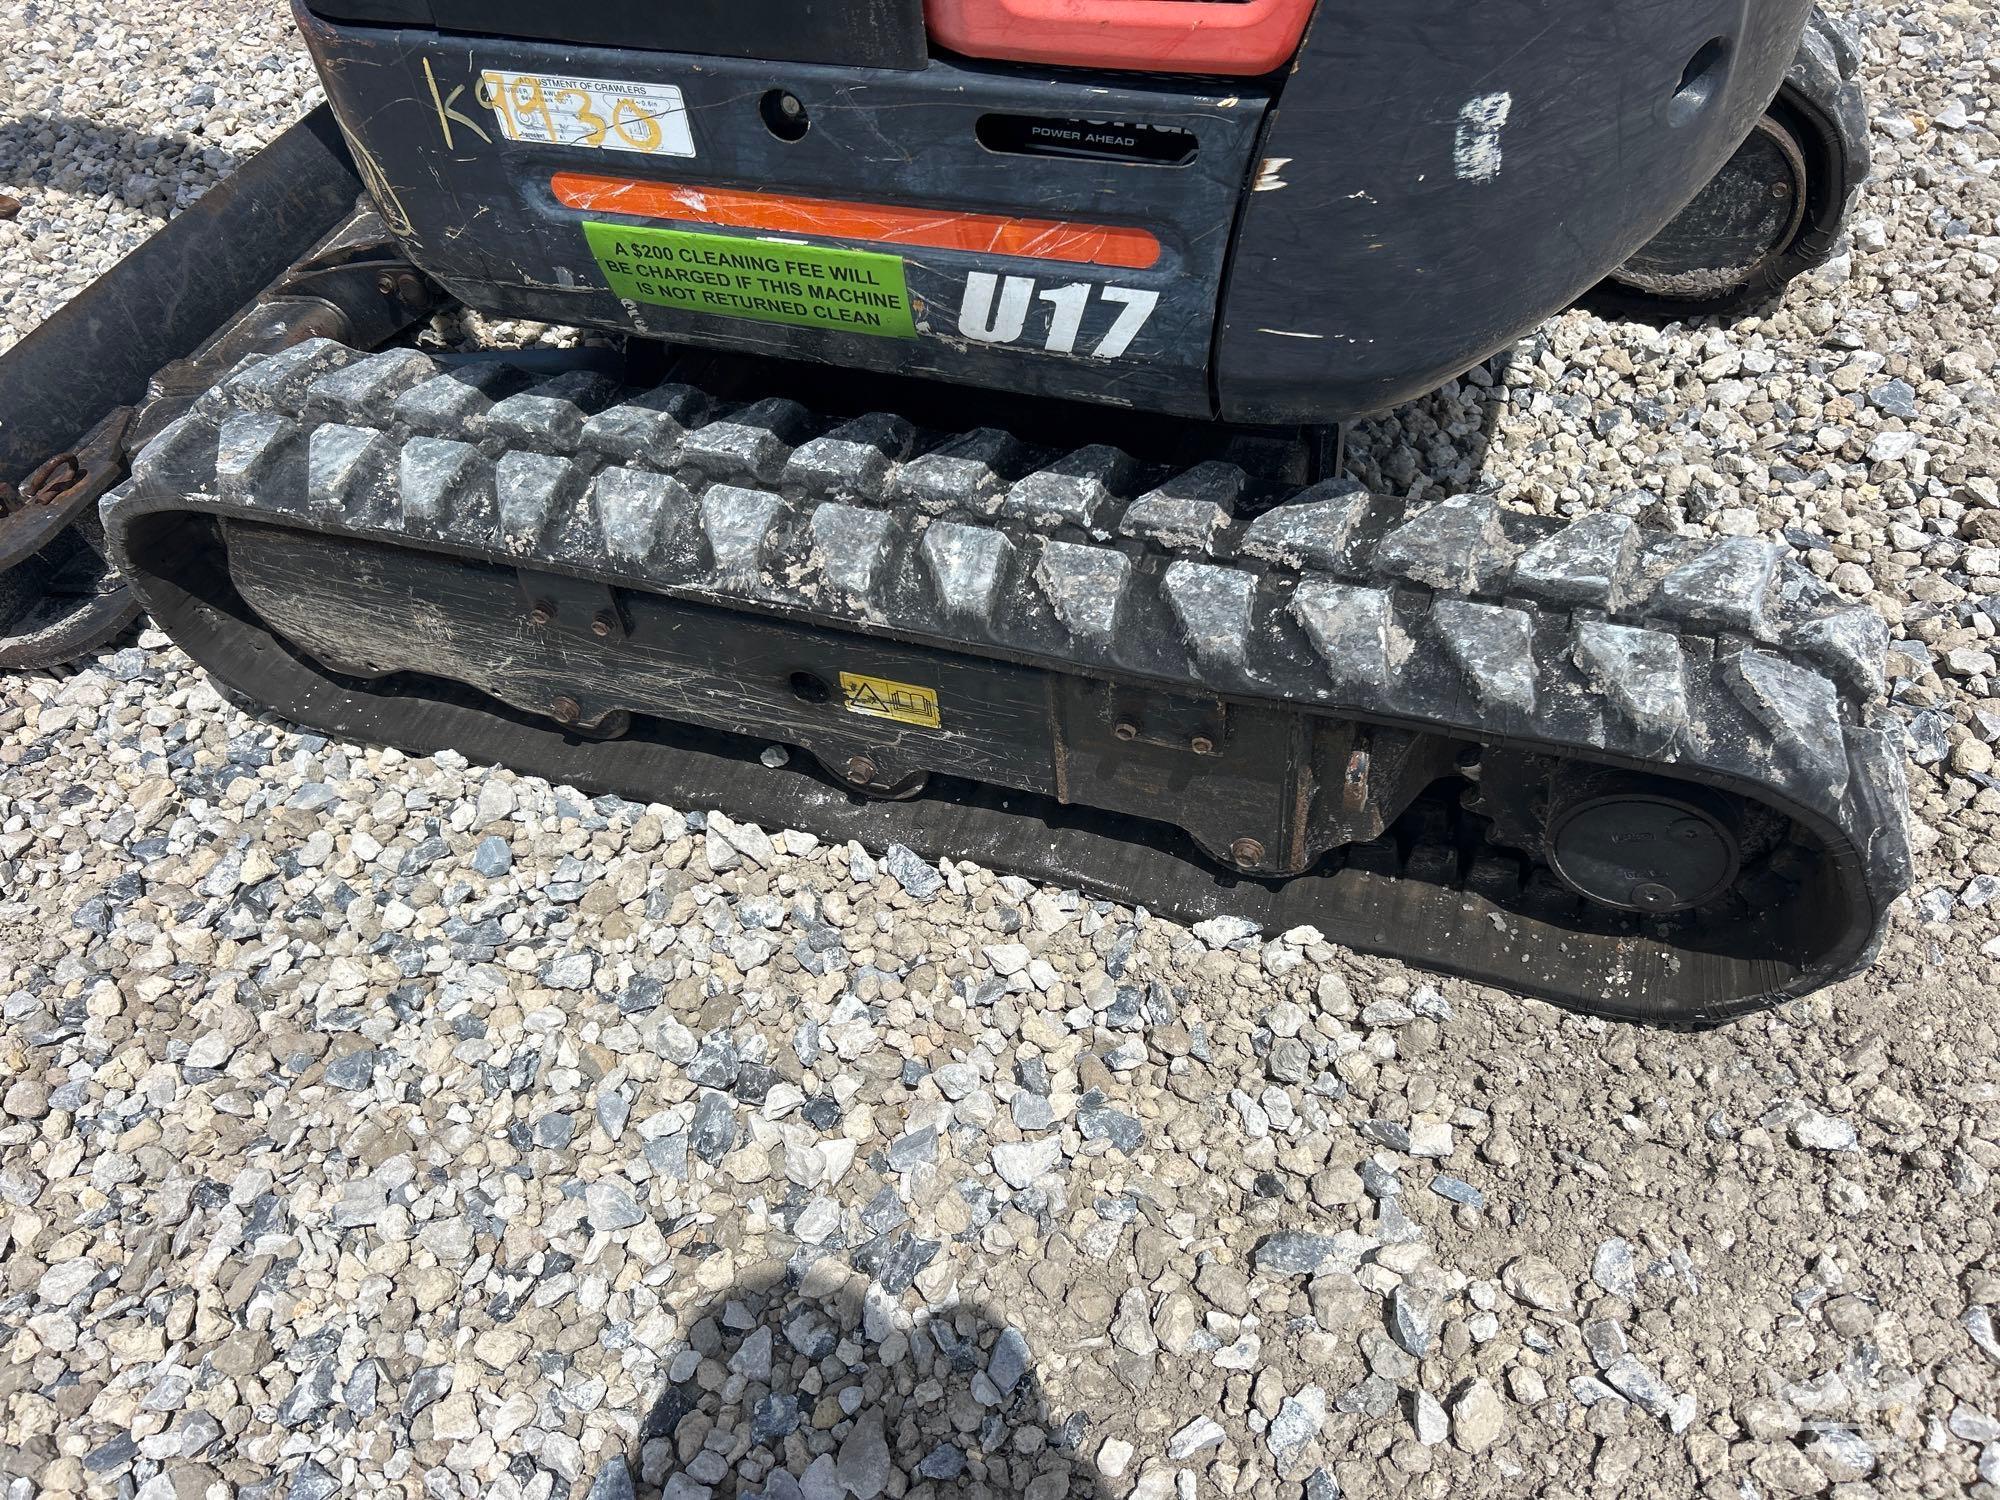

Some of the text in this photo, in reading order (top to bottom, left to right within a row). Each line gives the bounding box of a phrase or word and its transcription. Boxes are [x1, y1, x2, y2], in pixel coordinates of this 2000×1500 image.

[519, 76, 647, 95] ADUSTMENT OF CRAWLERS
[1032, 126, 1081, 140] POWER
[1085, 133, 1135, 146] AHEAD
[606, 259, 902, 310] BE CHARGED IF THIS MACHINE
[615, 242, 880, 286] A $200 CLEANING FEE WILL
[635, 281, 882, 327] IS NOT RETURNED CLEAN
[958, 271, 1160, 359] U17
